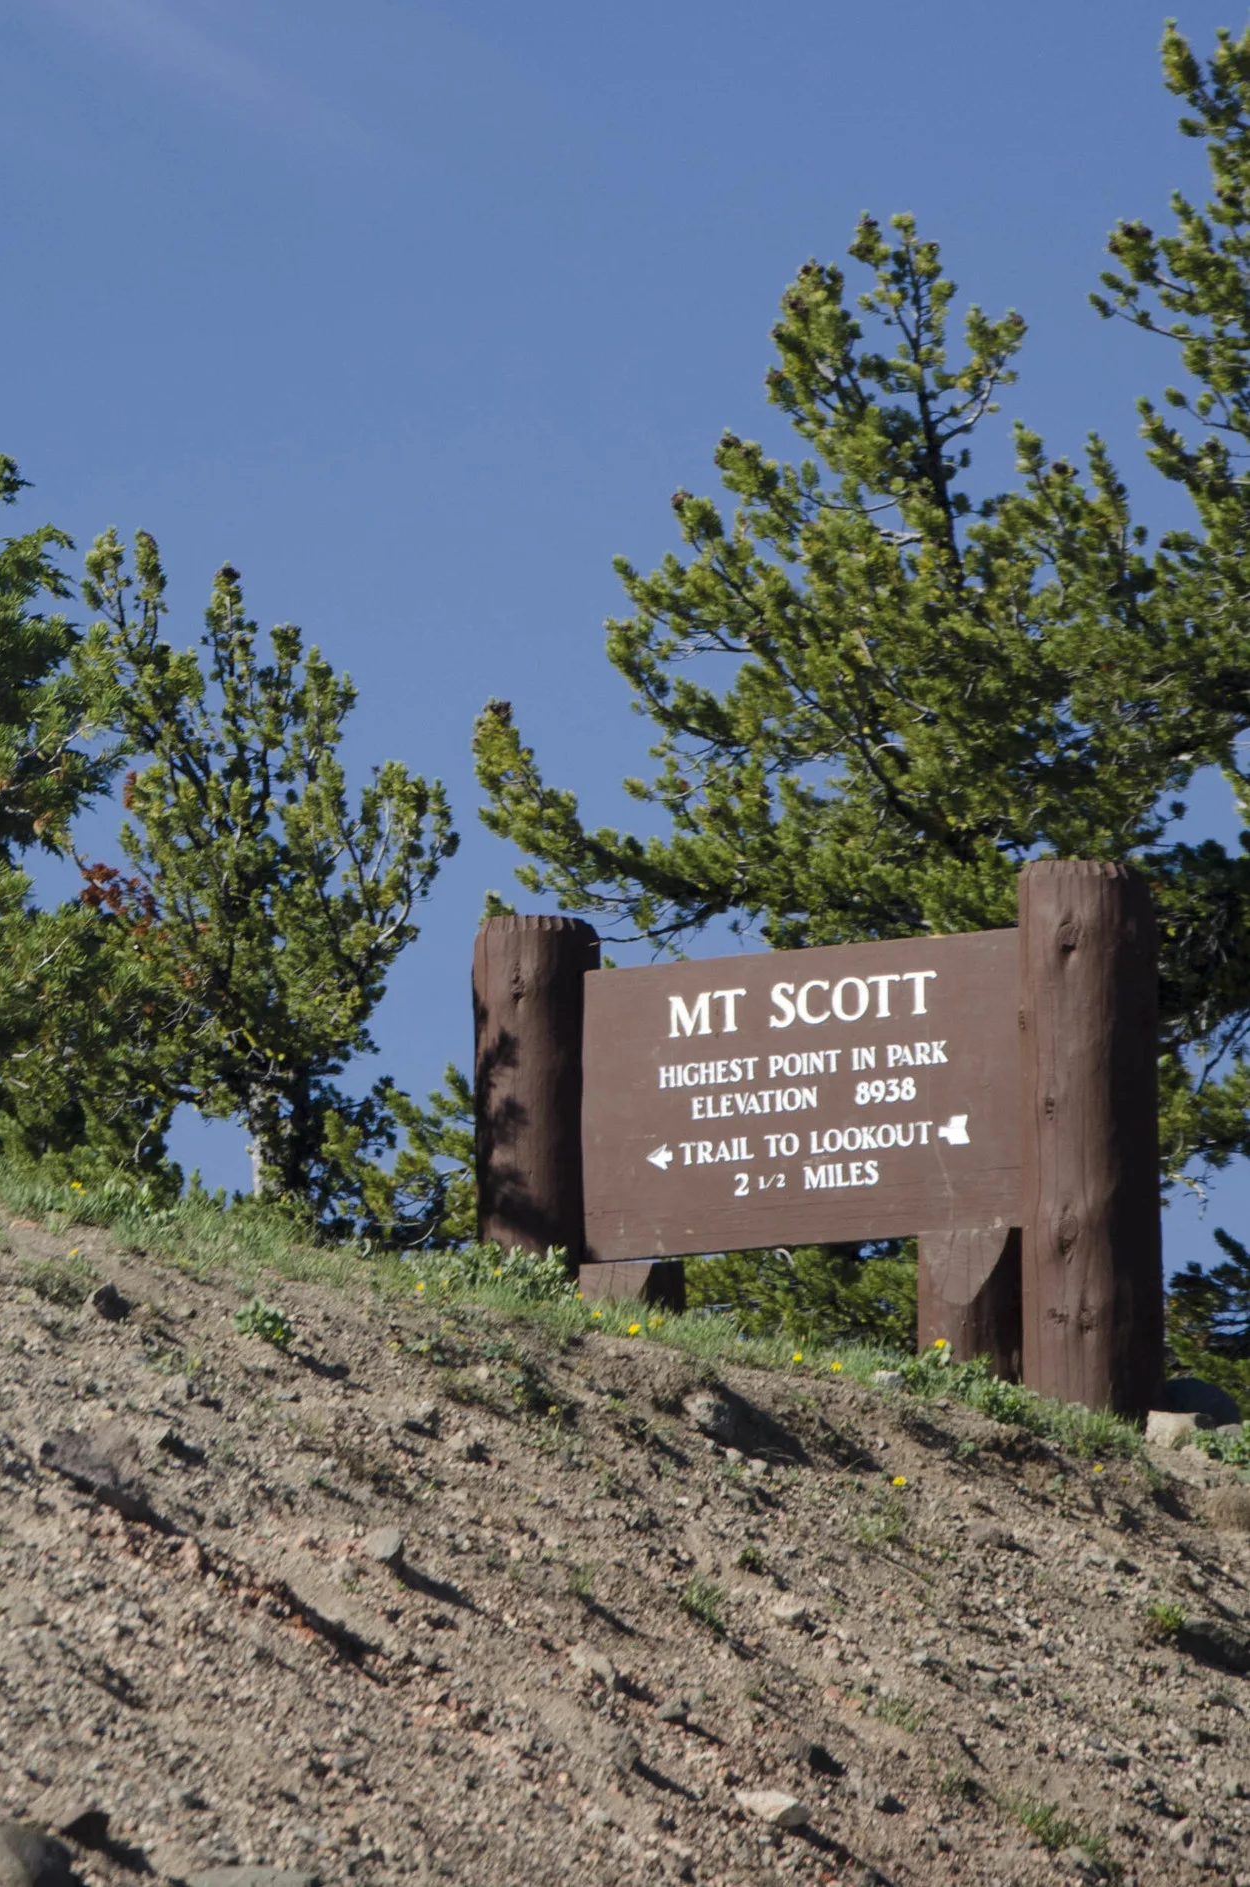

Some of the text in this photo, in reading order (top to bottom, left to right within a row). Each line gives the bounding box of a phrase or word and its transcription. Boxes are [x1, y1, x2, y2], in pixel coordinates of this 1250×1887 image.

[668, 970, 937, 1038] MT SCOTT
[658, 1040, 949, 1089] HIGHEST POINT IN PARK
[690, 1077, 916, 1120] ELEVATION 8938
[678, 1121, 933, 1165] TRAIL TO LOOKOUT
[803, 1160, 879, 1190] MILES
